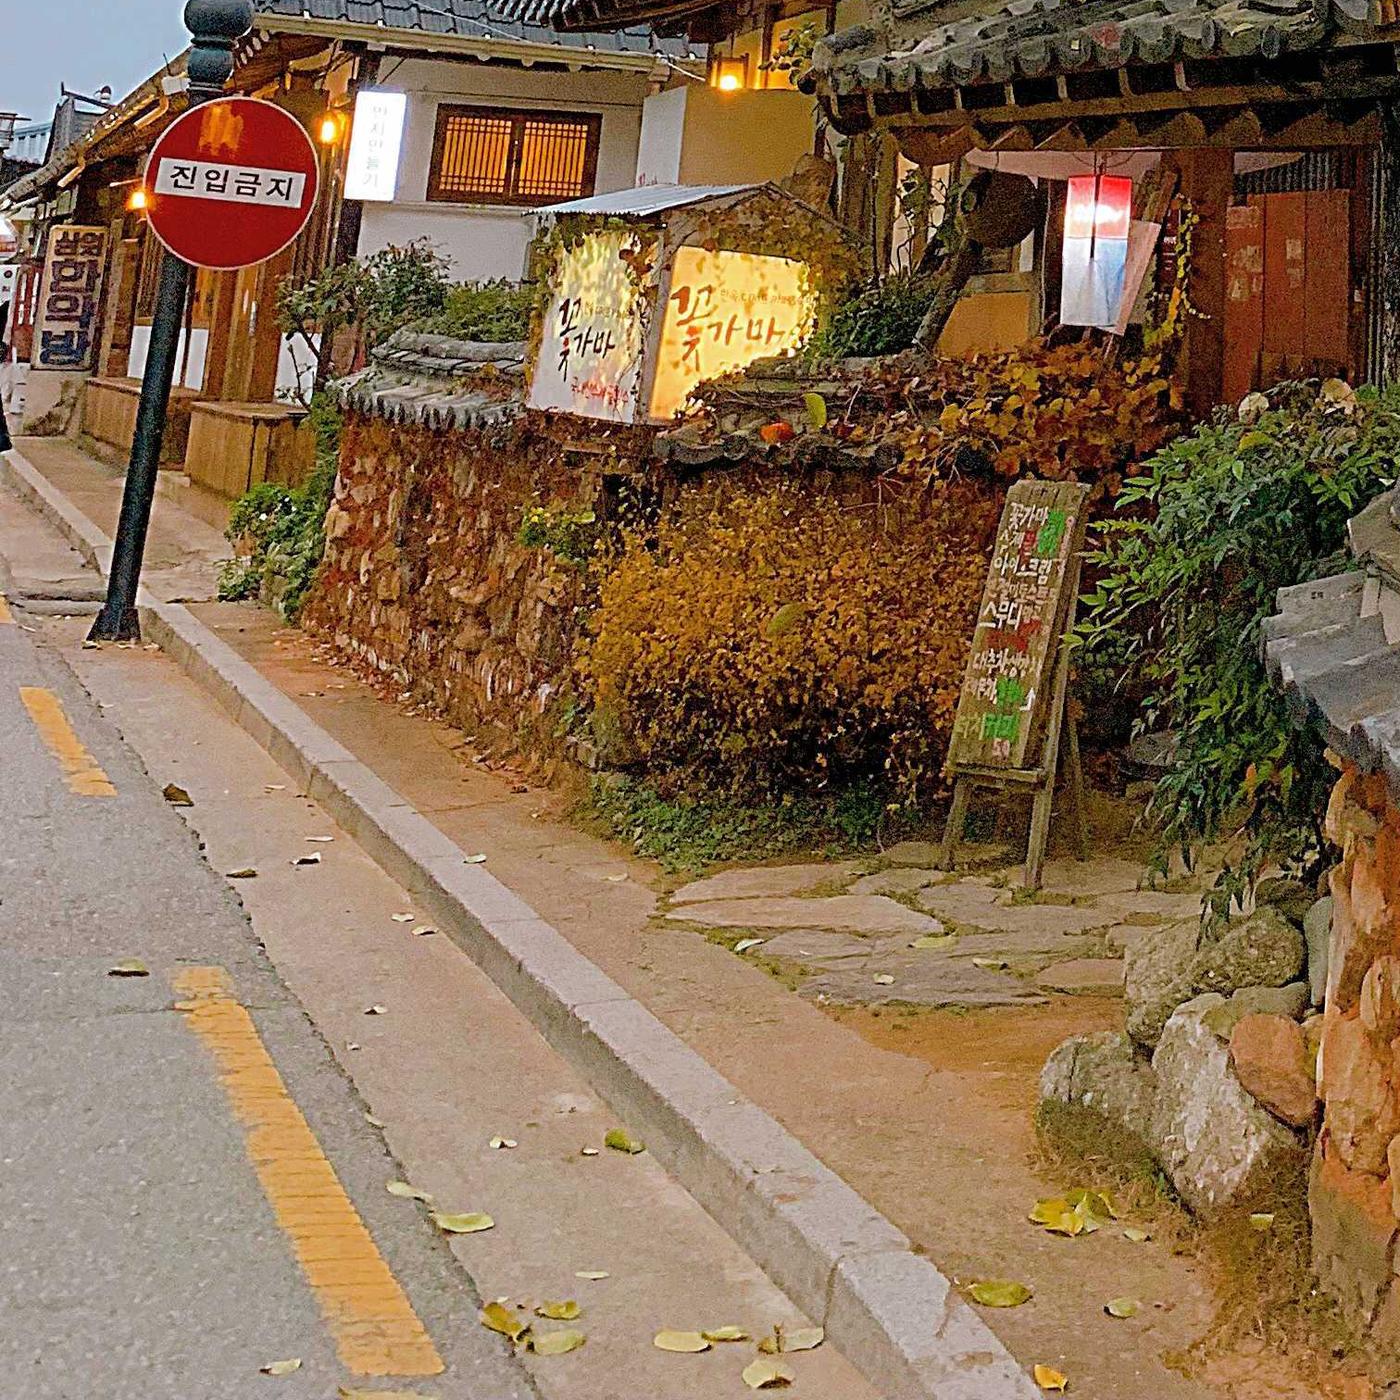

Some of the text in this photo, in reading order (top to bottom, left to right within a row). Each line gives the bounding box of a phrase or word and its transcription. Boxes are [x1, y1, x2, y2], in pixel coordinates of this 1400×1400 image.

[170, 165, 294, 201] 진입금지
[994, 553, 1052, 585] 아이스크림
[979, 601, 1022, 631] 스무디
